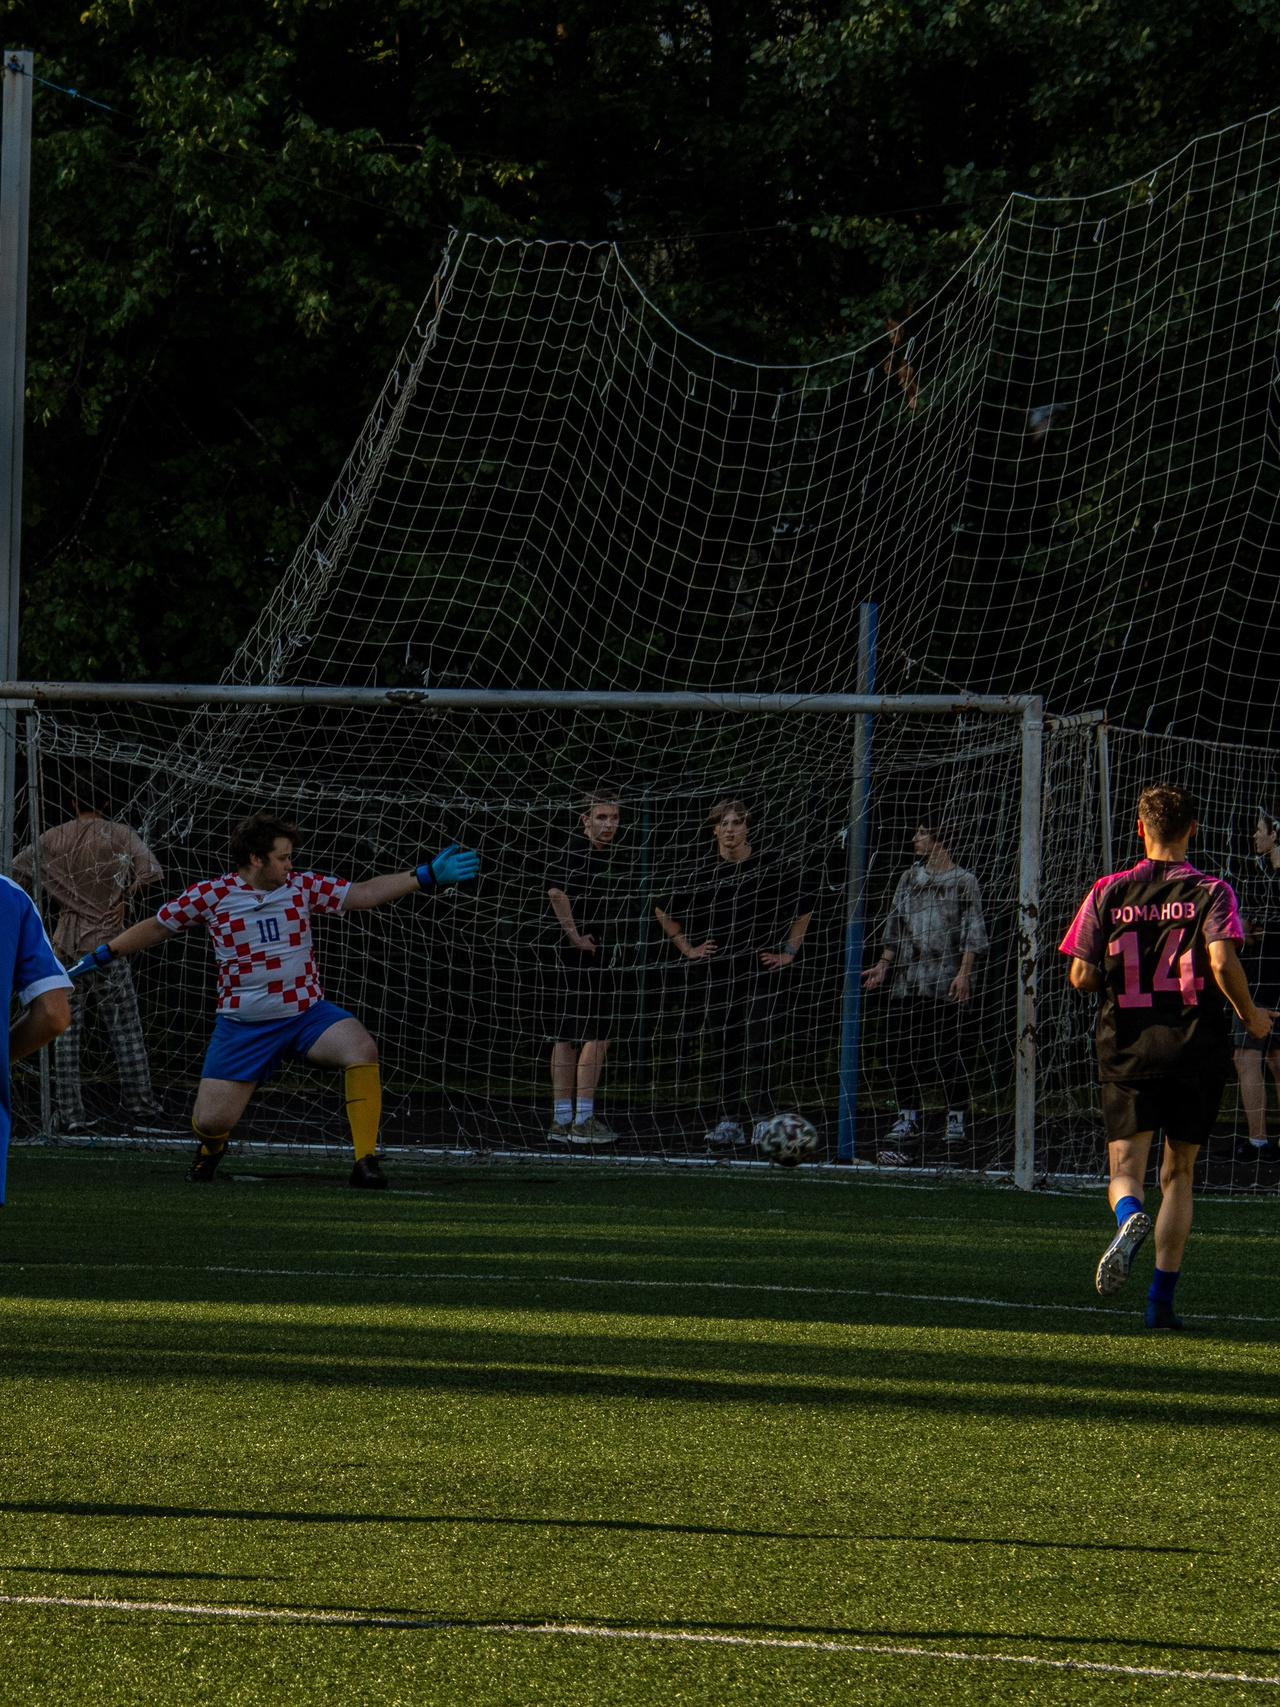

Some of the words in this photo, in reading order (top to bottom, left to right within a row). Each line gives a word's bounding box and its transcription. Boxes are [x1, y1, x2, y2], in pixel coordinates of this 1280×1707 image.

[1110, 902, 1195, 925] РОМАНОВ
[257, 918, 280, 943] 10
[1108, 927, 1205, 1009] 14
